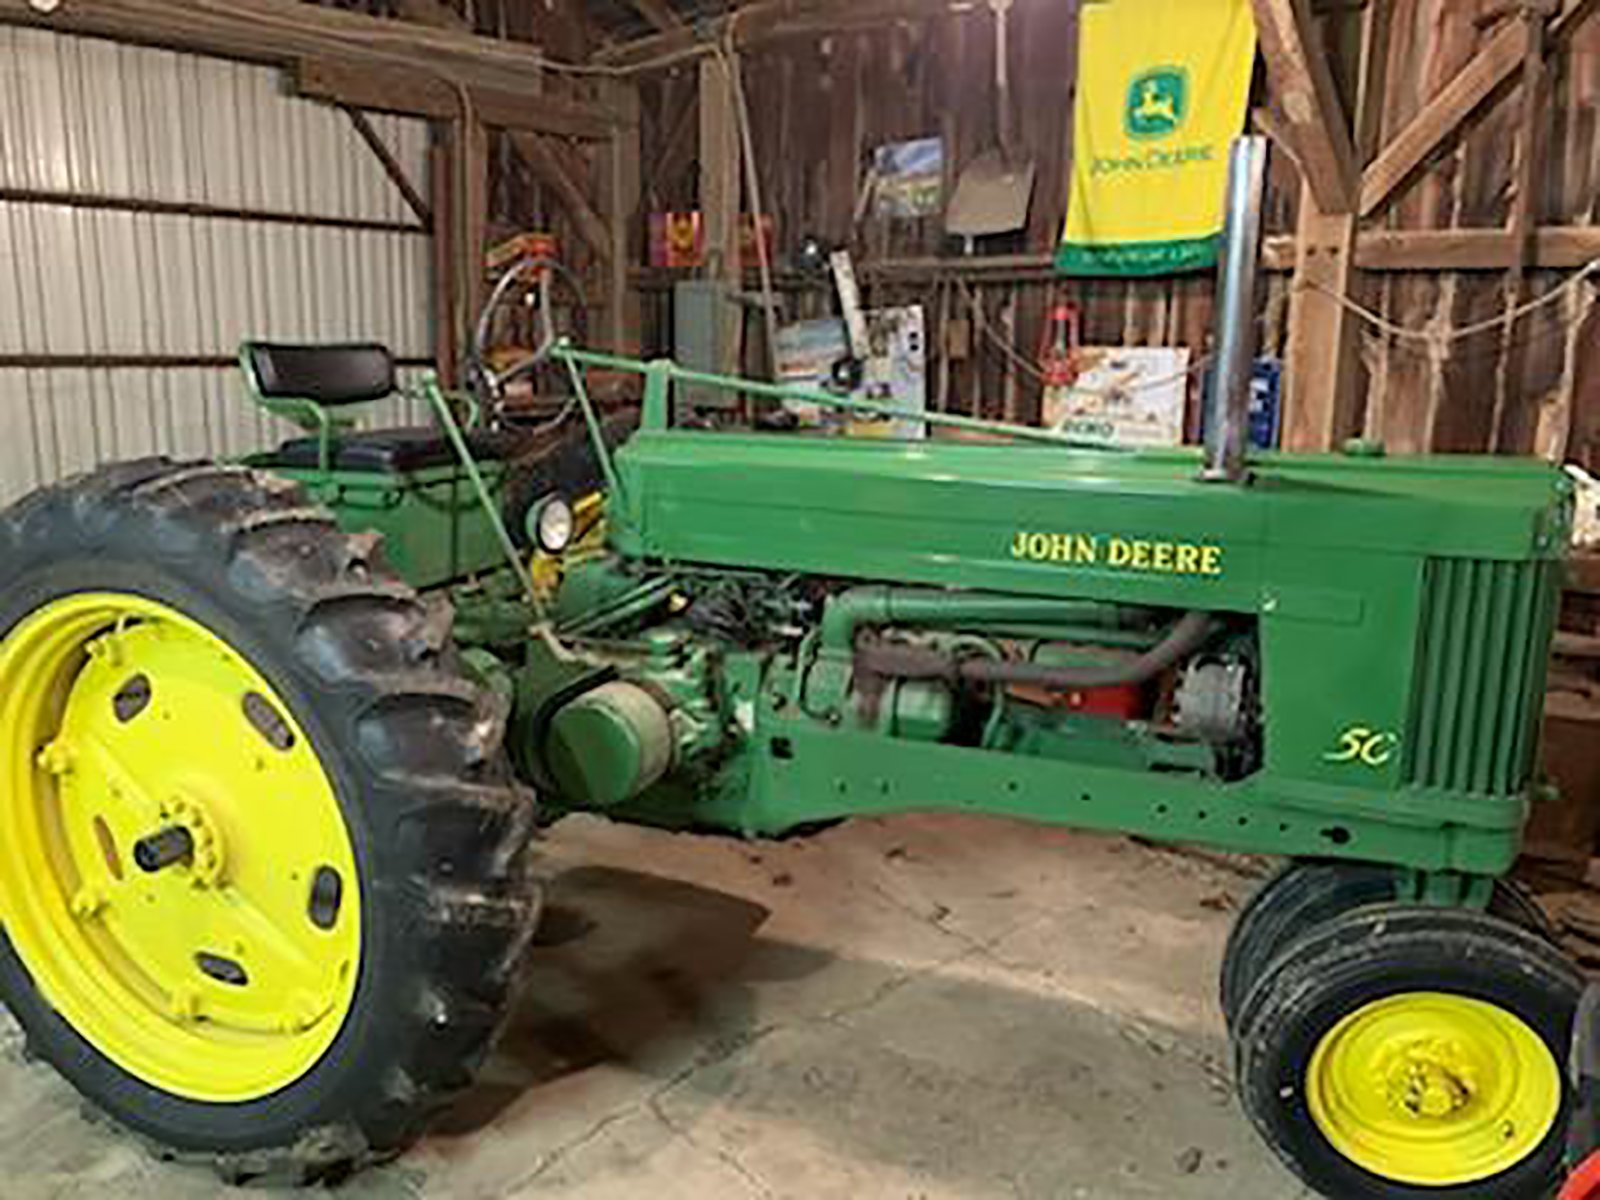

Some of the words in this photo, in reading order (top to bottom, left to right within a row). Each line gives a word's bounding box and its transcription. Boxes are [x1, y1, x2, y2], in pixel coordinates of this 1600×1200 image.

[1091, 157, 1146, 175] JOHN
[1010, 531, 1098, 563] JOHN
[1109, 539, 1222, 575] DEERE
